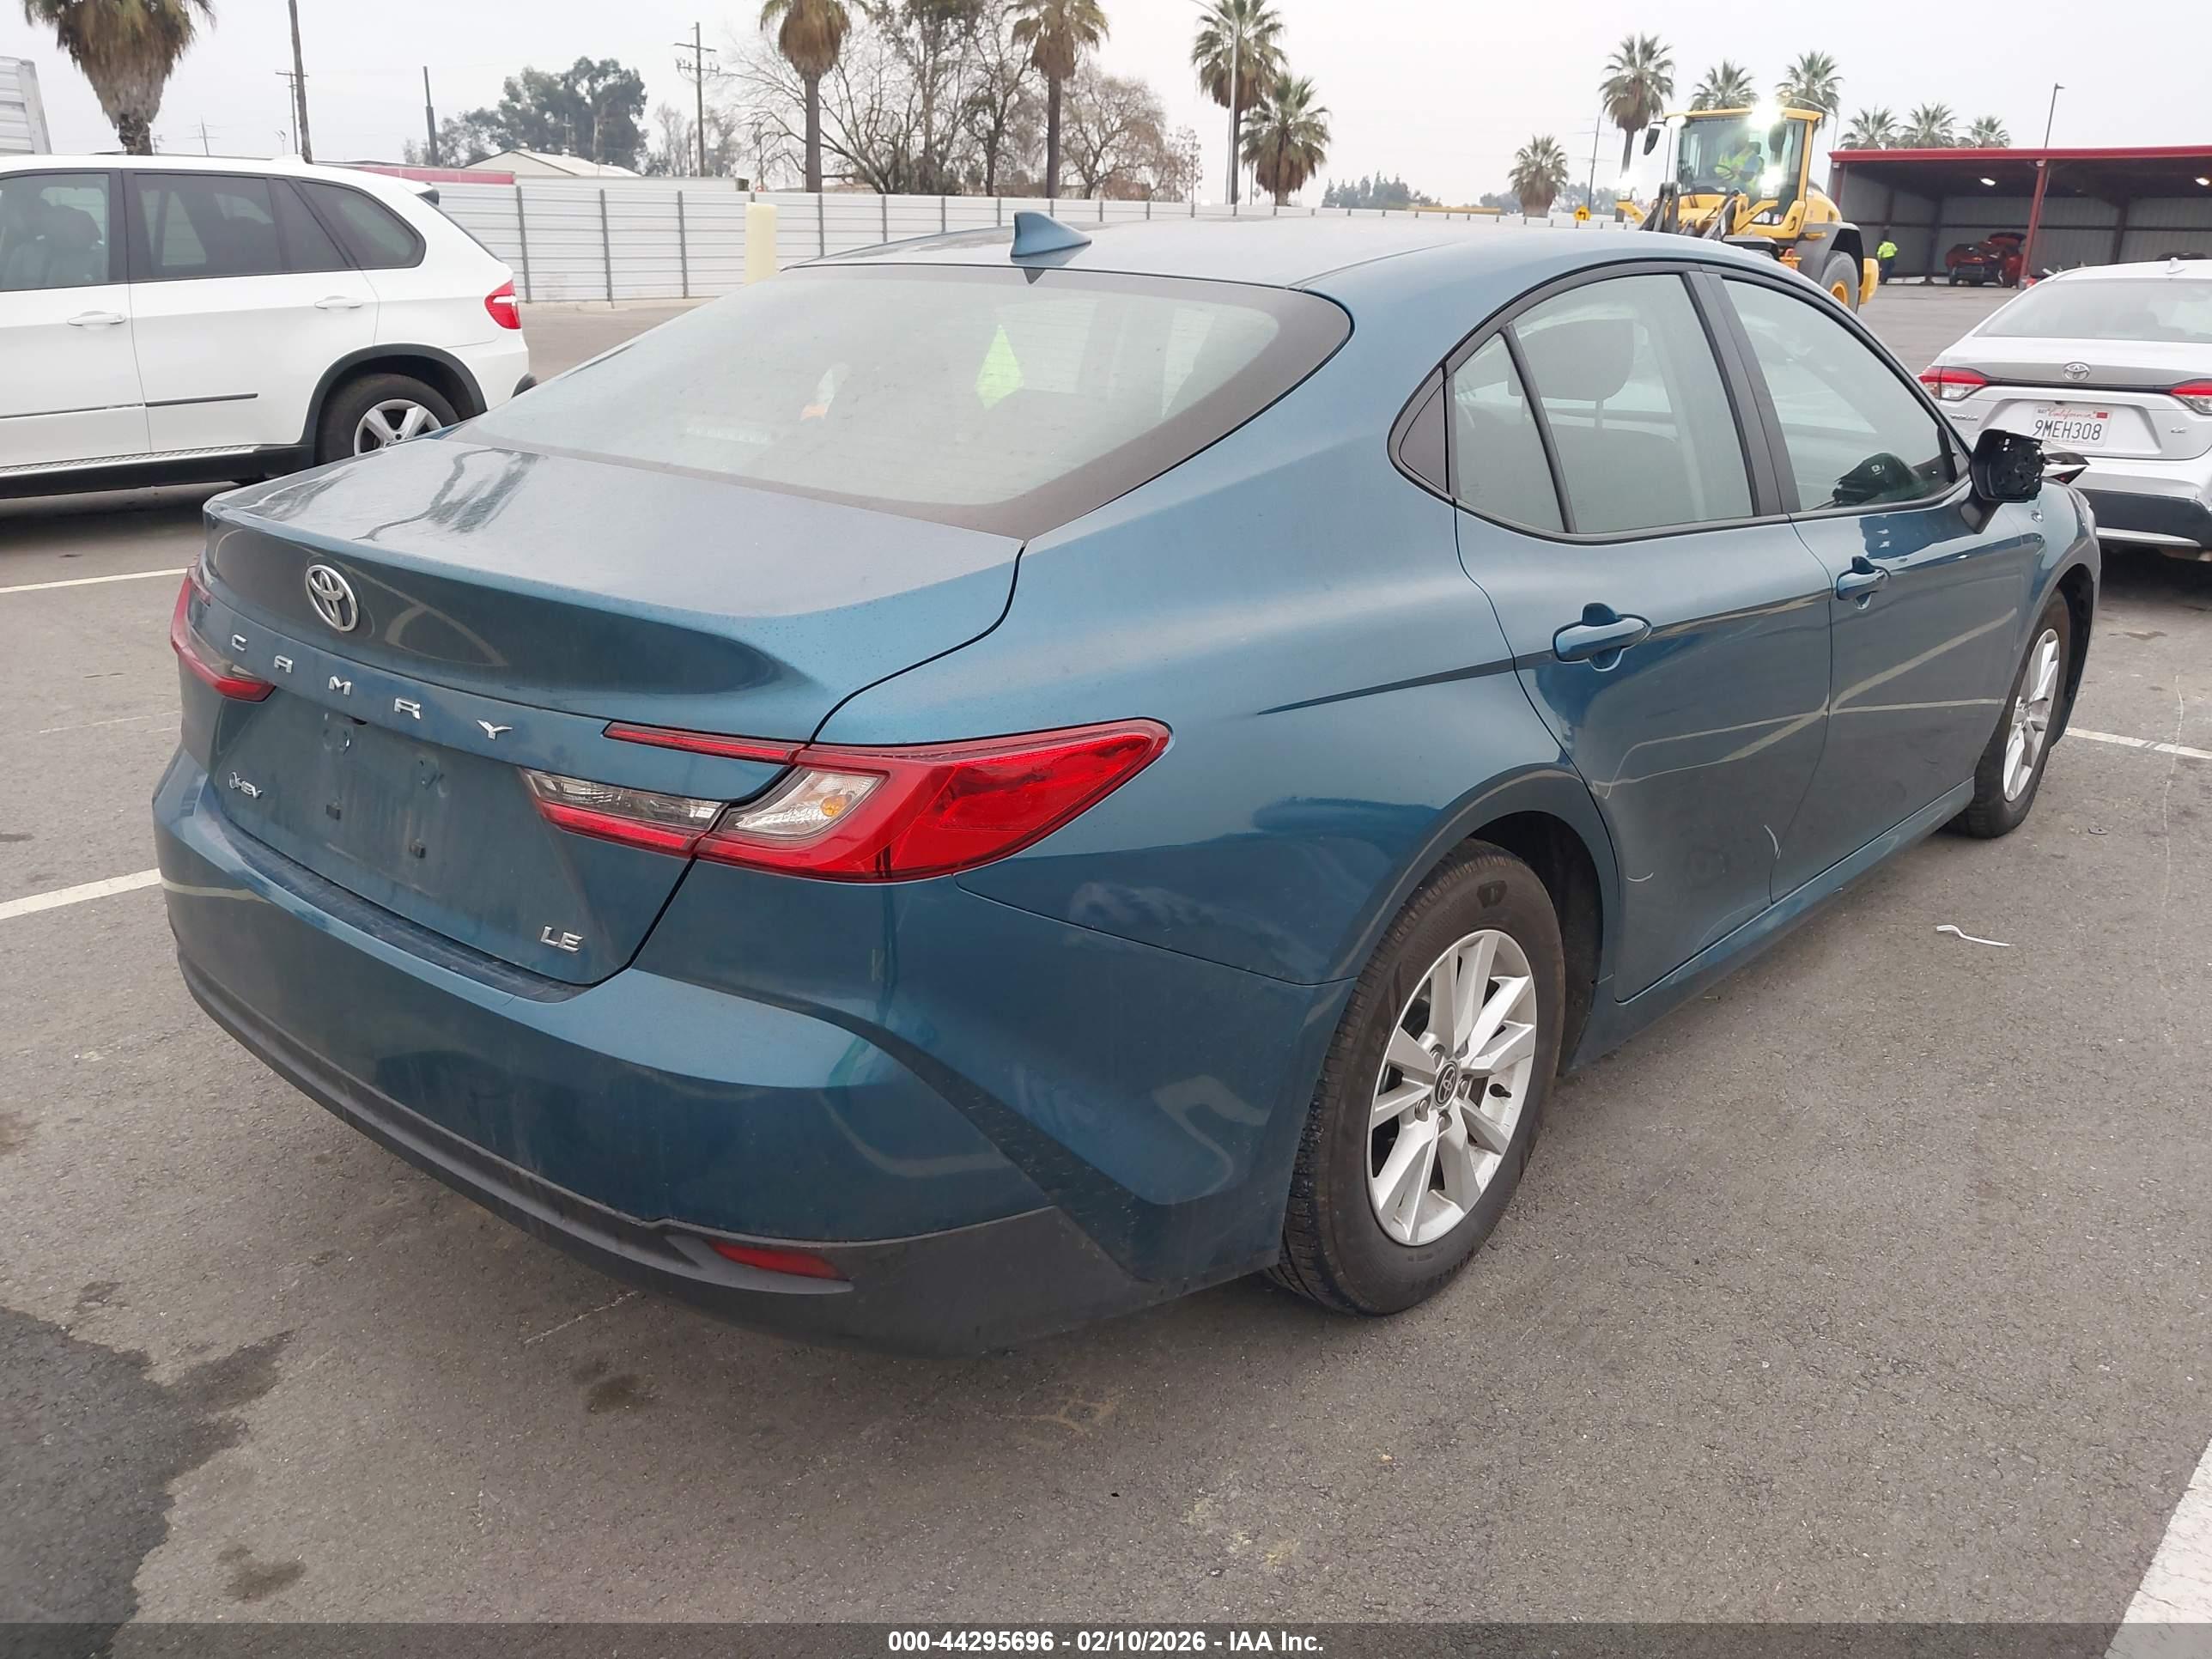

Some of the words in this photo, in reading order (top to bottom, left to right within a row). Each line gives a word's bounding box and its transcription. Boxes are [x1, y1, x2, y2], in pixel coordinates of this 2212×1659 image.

[2033, 419, 2102, 441] 9MEH308
[231, 633, 513, 740] CAMRY
[540, 926, 583, 952] LE
